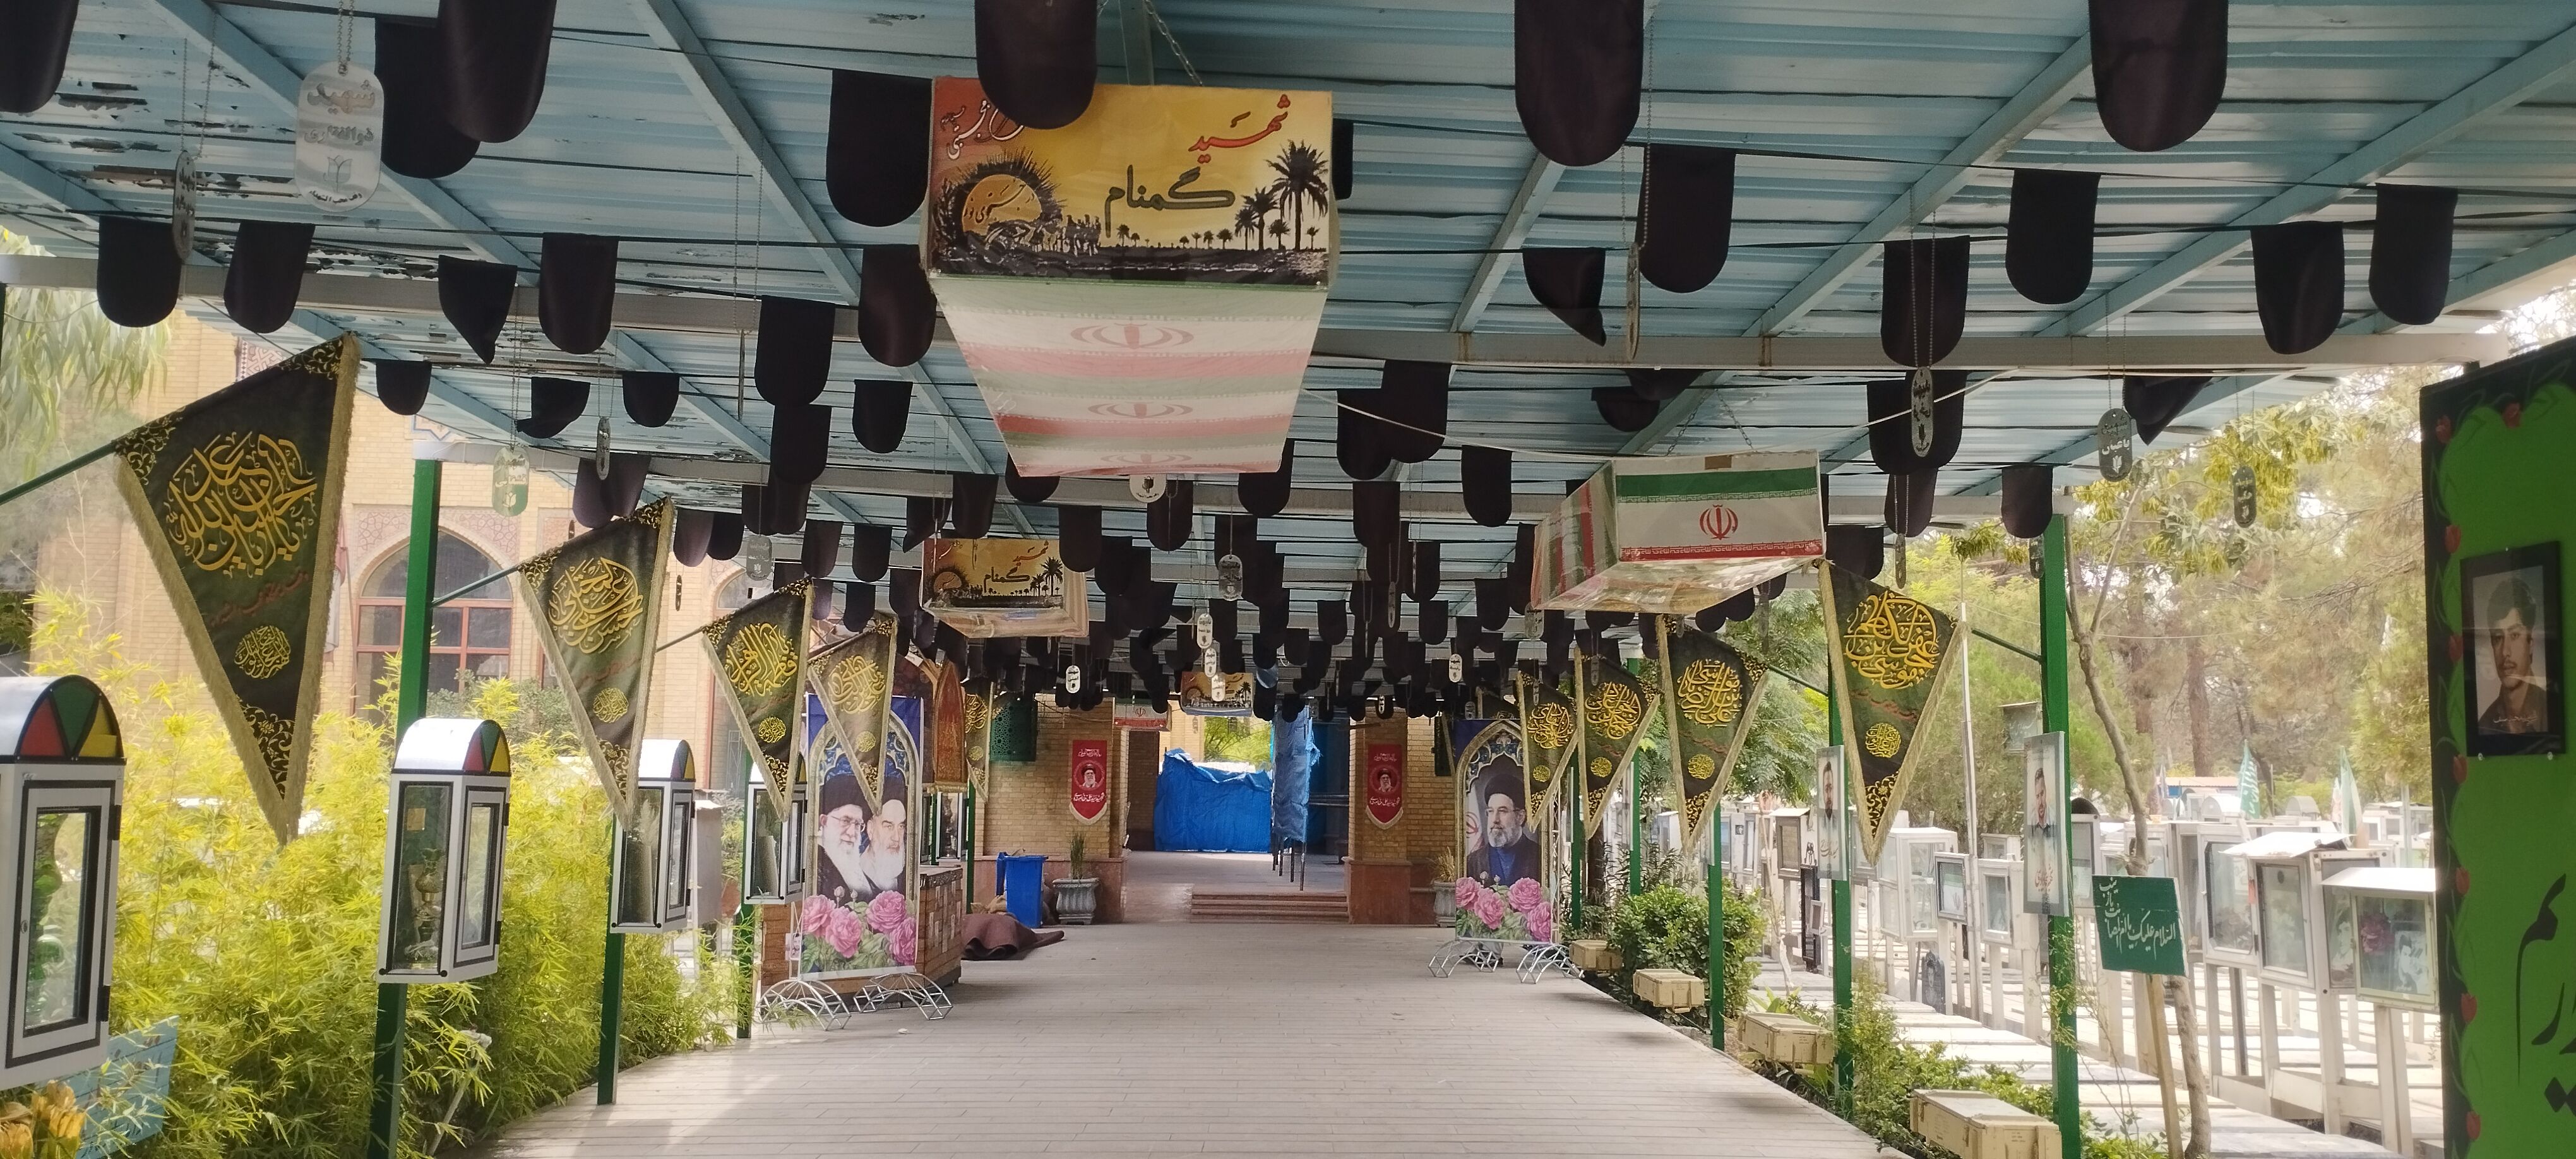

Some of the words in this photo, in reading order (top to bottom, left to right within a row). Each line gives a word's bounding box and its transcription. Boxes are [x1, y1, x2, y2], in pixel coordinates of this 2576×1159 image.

[307, 79, 375, 114] شهید
[1189, 93, 1290, 164] شهید
[1104, 164, 1236, 239] گمنام
[1012, 540, 1049, 566] شهید
[984, 566, 1030, 593] گمنام
[2127, 910, 2156, 951] علیک
[2154, 922, 2176, 960] السلام
